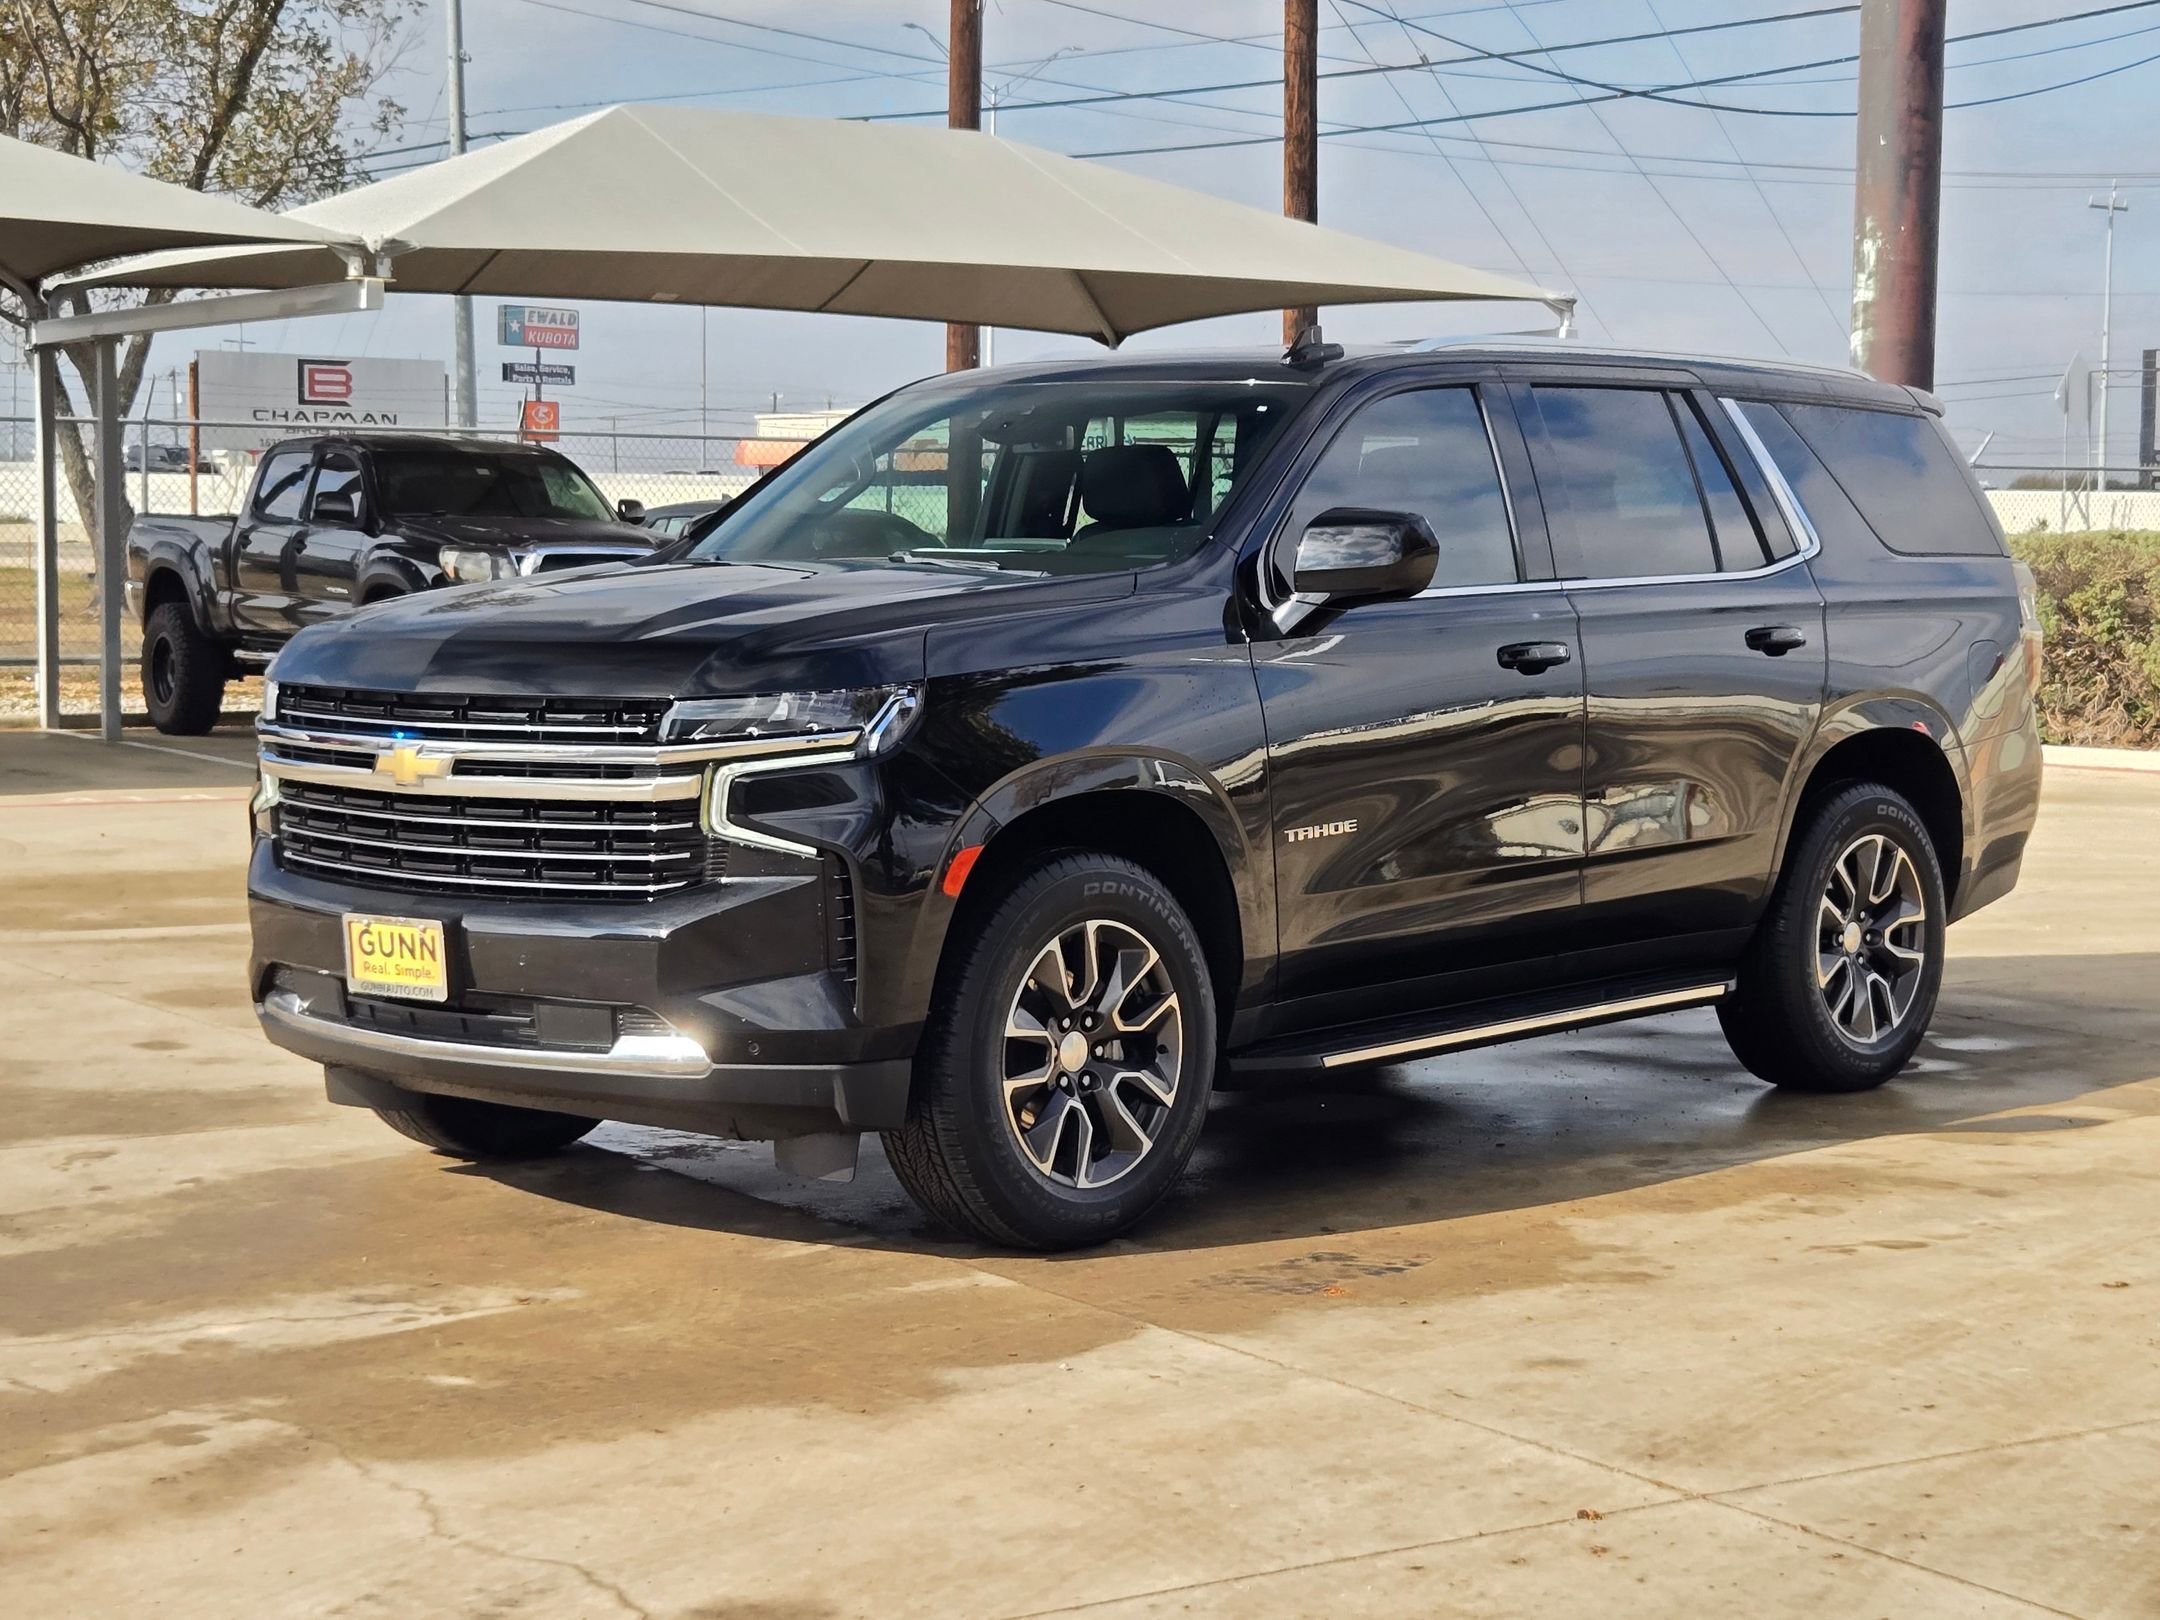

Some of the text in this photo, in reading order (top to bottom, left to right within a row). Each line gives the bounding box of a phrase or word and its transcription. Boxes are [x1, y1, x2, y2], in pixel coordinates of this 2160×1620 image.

[527, 310, 577, 326] EWALD
[528, 330, 576, 346] KUBOTA
[252, 409, 398, 426] CHAPMAN
[1284, 819, 1357, 842] TAHOE
[358, 928, 437, 962] GUNN
[363, 961, 435, 980] Real. Simple.
